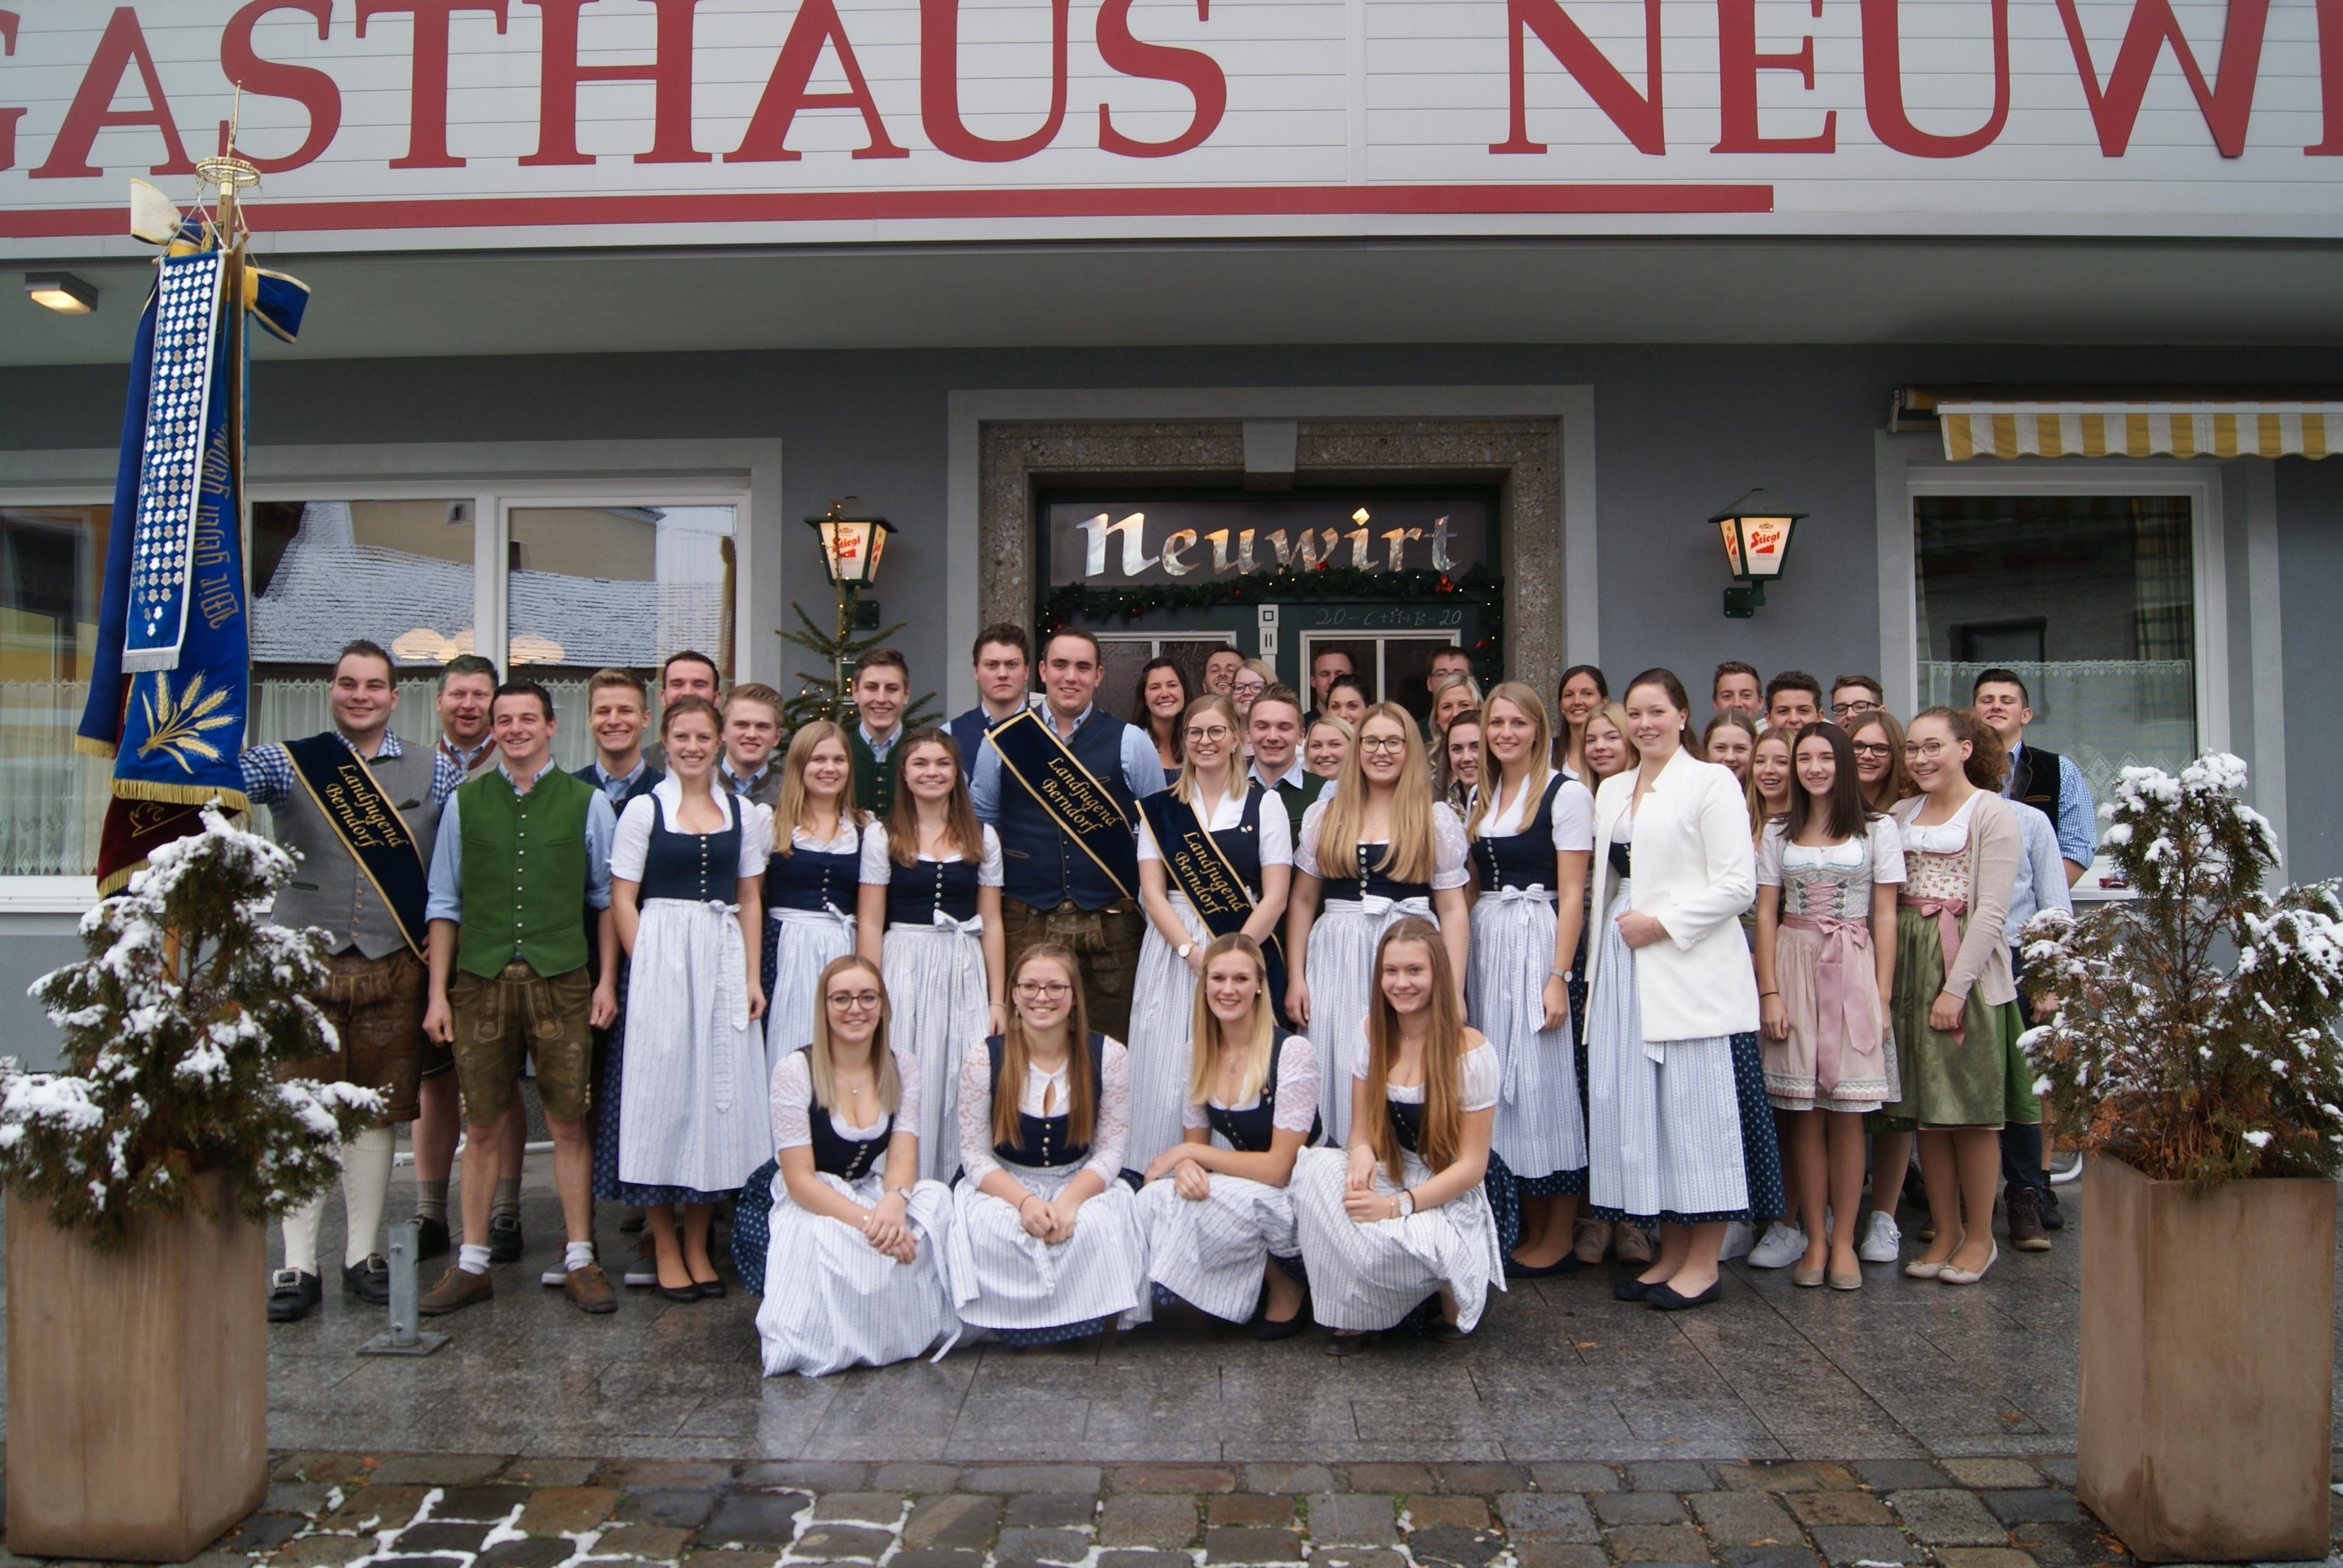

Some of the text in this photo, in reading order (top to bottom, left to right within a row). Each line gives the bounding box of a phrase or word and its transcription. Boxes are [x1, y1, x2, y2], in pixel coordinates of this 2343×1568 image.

[0, 0, 1227, 179] ASTHAUS
[1751, 531, 1780, 549] Stiegl
[324, 783, 384, 848] Berndorf
[337, 764, 410, 848] Landjugend
[1041, 778, 1104, 834] Berndorf
[1047, 757, 1122, 827] Landjugend
[1174, 851, 1228, 915] Berndorf
[1183, 831, 1250, 912] Landjugend
